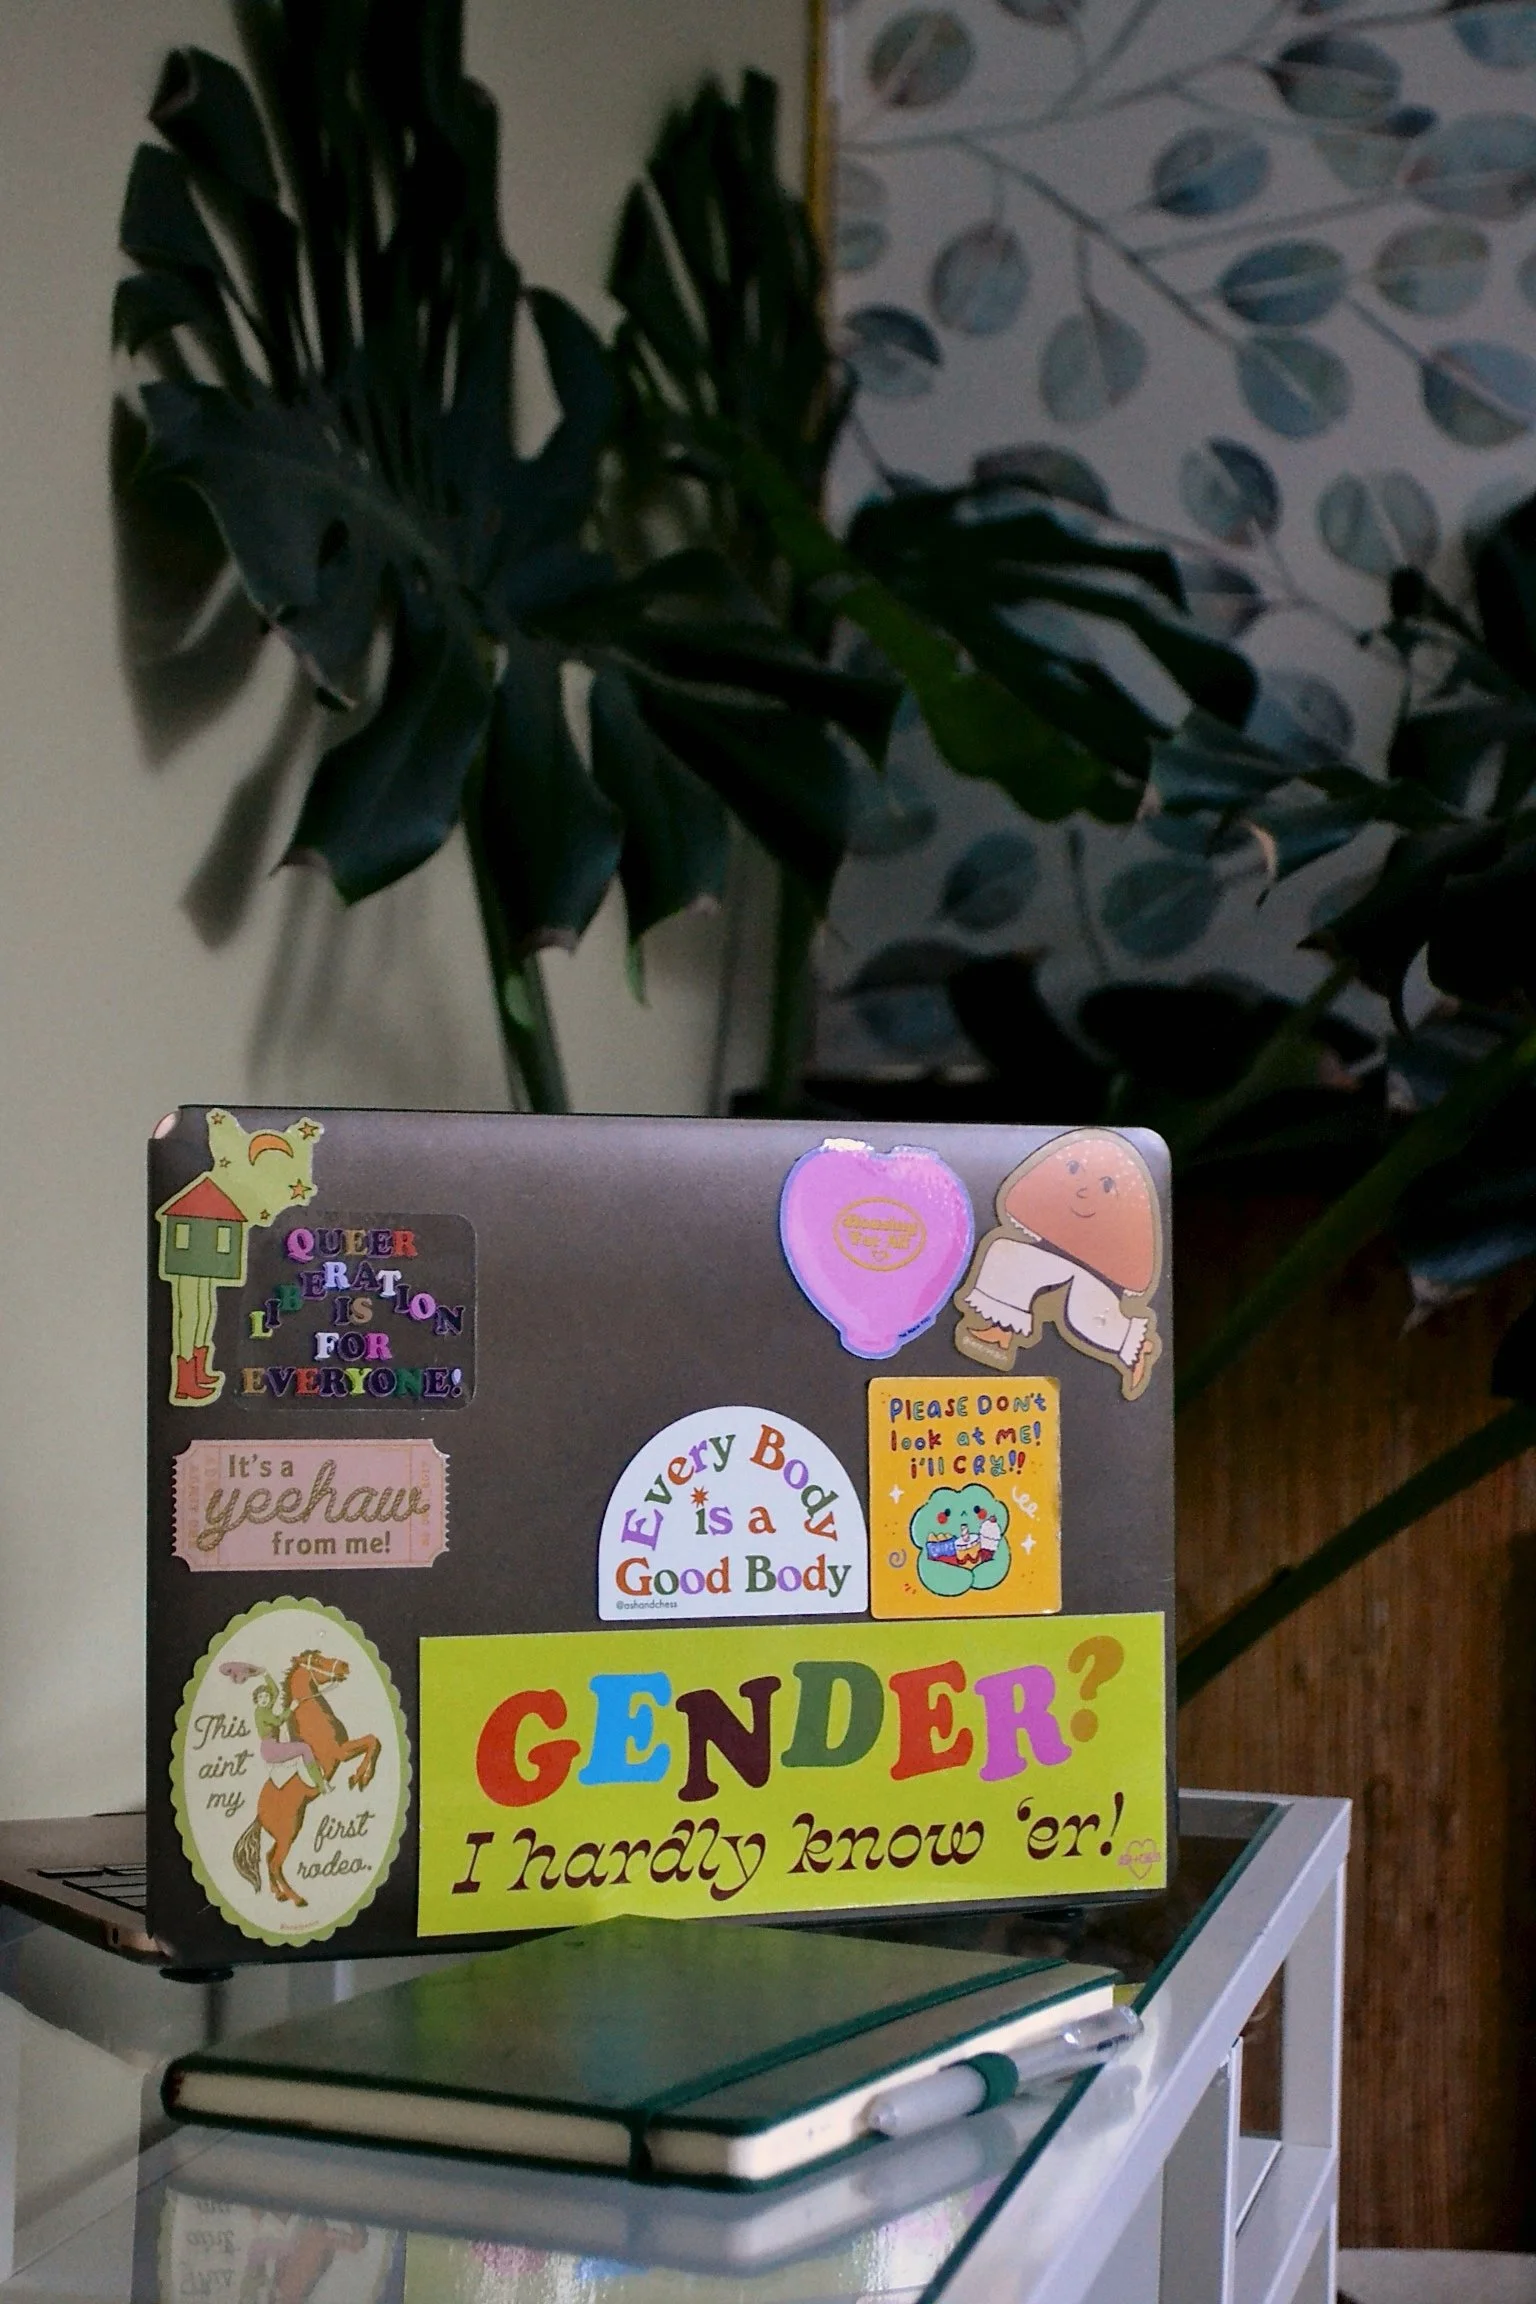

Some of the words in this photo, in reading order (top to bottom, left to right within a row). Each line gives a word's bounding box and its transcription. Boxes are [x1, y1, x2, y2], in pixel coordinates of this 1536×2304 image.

[286, 1228, 418, 1263] QUEER
[250, 1261, 464, 1338] LIBERATION
[334, 1297, 374, 1326] IS
[315, 1332, 392, 1361] FOR
[243, 1366, 463, 1398] EVERYONE!
[891, 1429, 942, 1451] look
[957, 1427, 985, 1446] at
[995, 1421, 1042, 1446] ME!
[228, 1453, 273, 1478] It's
[280, 1459, 294, 1478] a
[620, 1433, 736, 1551] Every
[749, 1423, 840, 1542] Body
[196, 1459, 431, 1551] yeehaw
[690, 1486, 734, 1536] is
[747, 1505, 777, 1534] a
[271, 1530, 337, 1556] from
[345, 1531, 391, 1554] me!
[615, 1556, 731, 1596] Good
[744, 1553, 852, 1598] Body
[615, 1600, 678, 1610] @ashandchess
[192, 1714, 251, 1750] This
[476, 1635, 1125, 1807] GENDER?
[198, 1749, 255, 1780] aint
[206, 1788, 246, 1817] my
[313, 1811, 376, 1853] first
[297, 1850, 373, 1880] rodeo.
[451, 1831, 495, 1894] I
[507, 1817, 766, 1901] hardly
[787, 1812, 985, 1875] know
